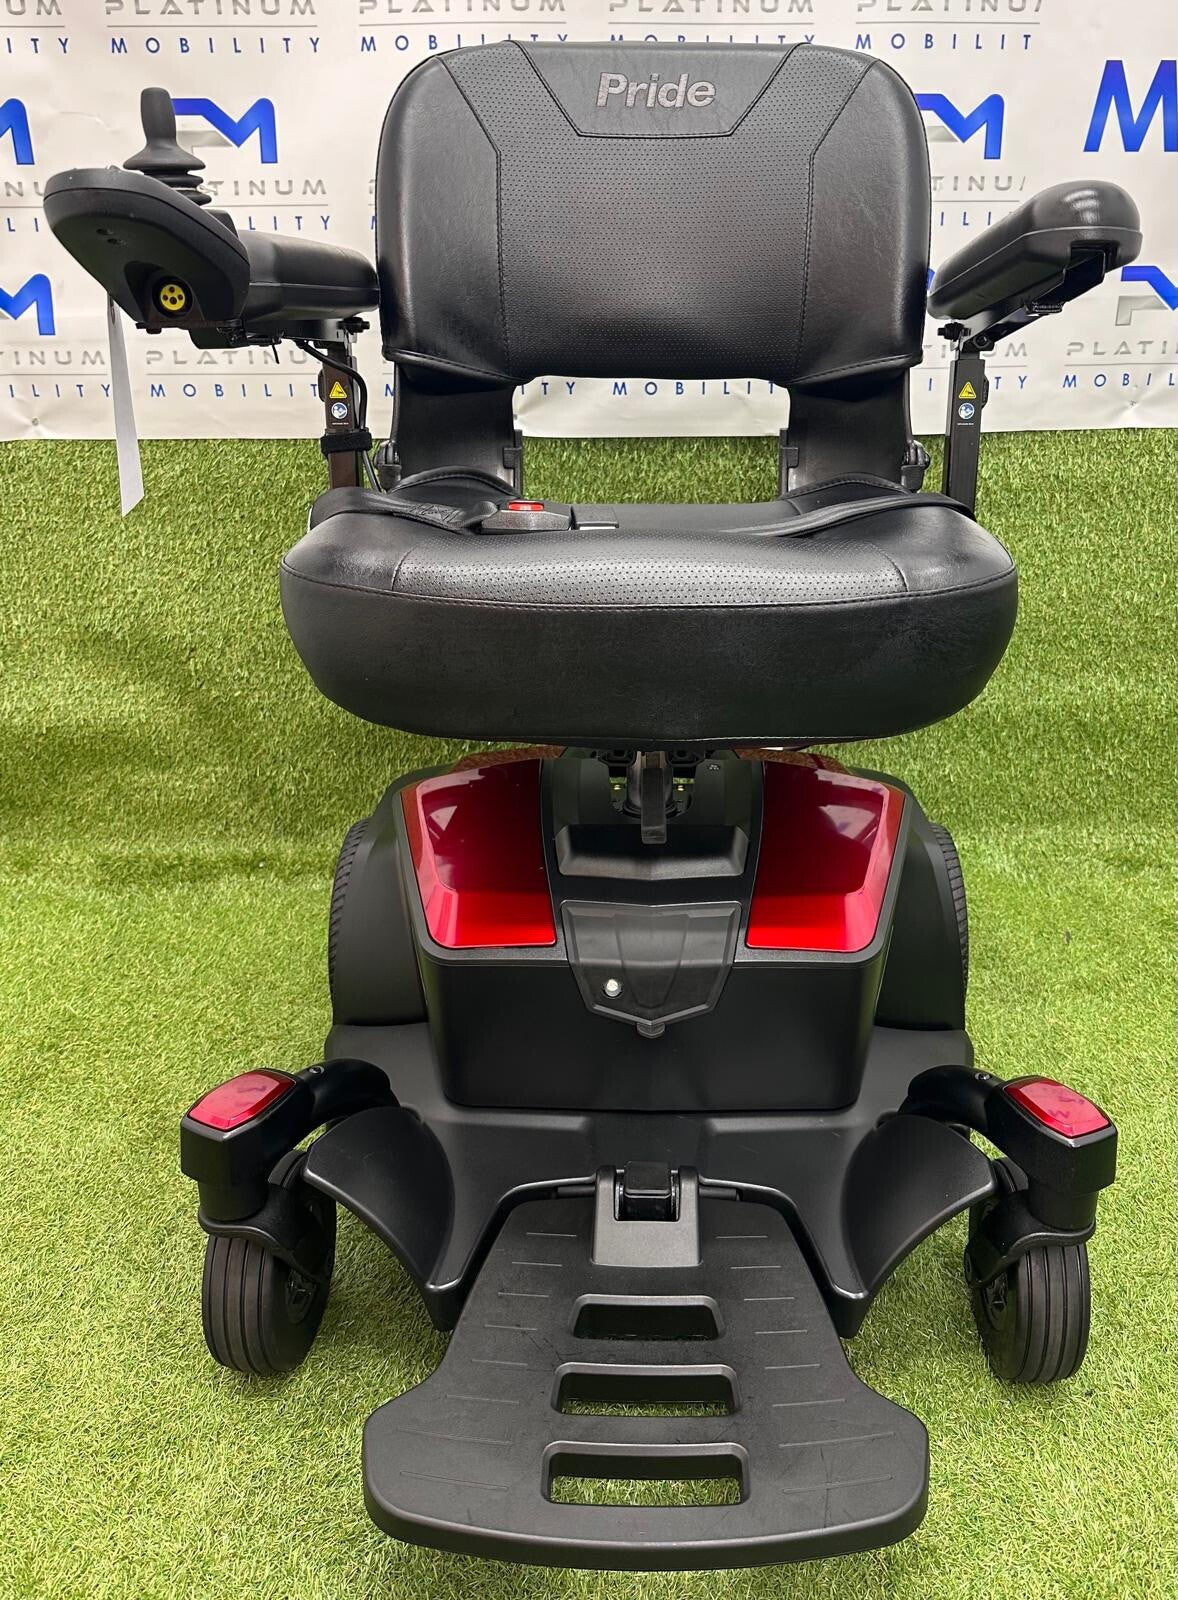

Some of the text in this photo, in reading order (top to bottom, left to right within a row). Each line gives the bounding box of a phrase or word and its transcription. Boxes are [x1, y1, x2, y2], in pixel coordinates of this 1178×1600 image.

[105, 0, 316, 15] PLATINUM
[111, 37, 320, 54] MOBILITY
[855, 33, 1032, 50] MOBILIT
[596, 72, 716, 108] Pride
[207, 178, 327, 196] TINUM
[146, 350, 323, 366] PLATINU
[150, 383, 317, 398] MOBILIT
[612, 380, 775, 396] MOBILIT
